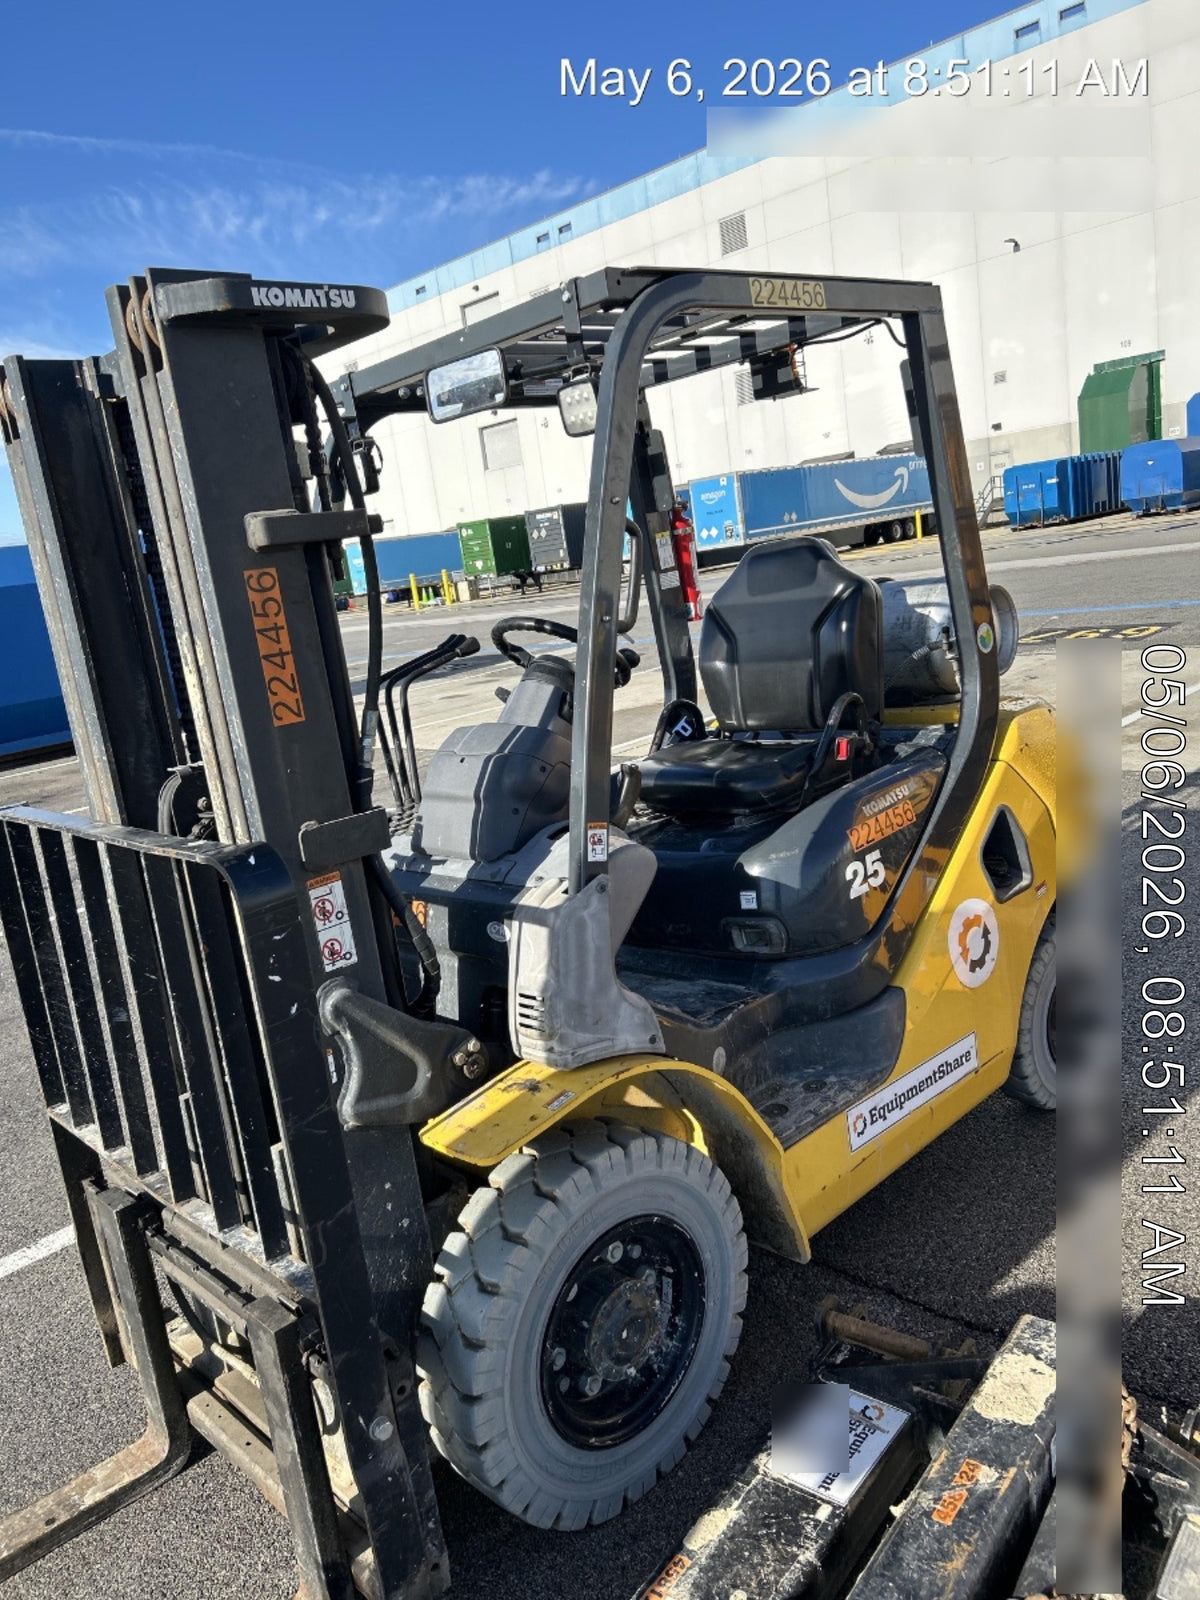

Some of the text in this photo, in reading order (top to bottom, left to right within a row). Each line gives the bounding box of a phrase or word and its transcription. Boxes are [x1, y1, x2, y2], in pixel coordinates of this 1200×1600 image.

[250, 285, 356, 308] KOMATSU
[751, 279, 826, 308] 224456
[700, 490, 726, 502] amazon
[246, 571, 303, 721] 224456
[862, 784, 910, 817] KOMATSU
[849, 801, 915, 851] 224456
[845, 849, 886, 900] 25
[868, 1049, 972, 1126] EquipmentShare
[818, 1423, 877, 1492] Equient
